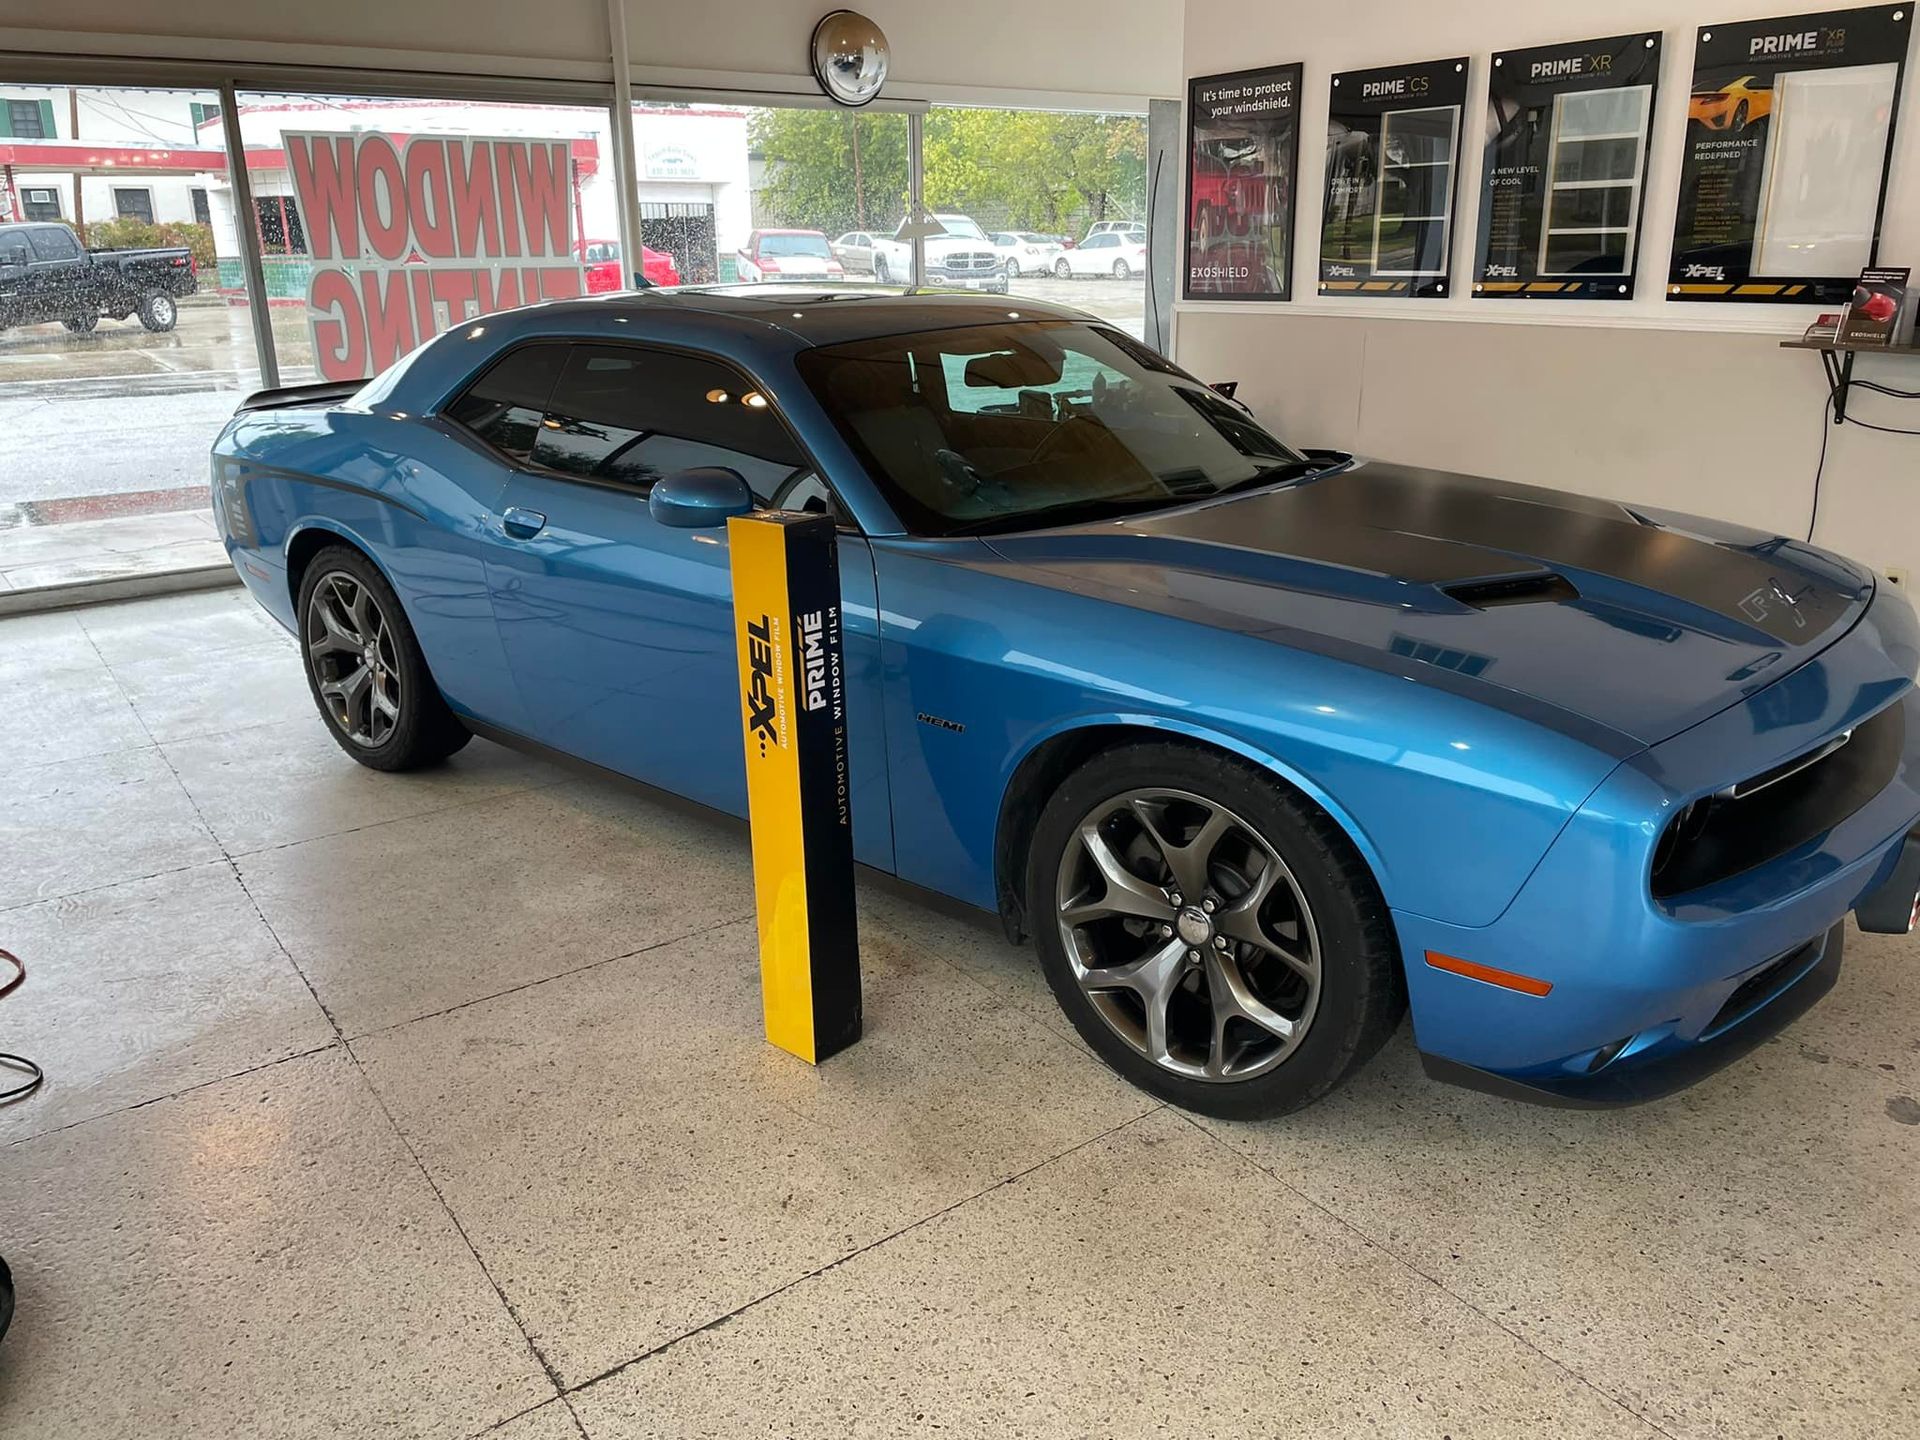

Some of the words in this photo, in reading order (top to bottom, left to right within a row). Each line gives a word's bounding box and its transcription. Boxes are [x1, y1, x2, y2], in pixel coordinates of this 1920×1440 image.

[1749, 31, 1818, 55] PRIME
[1827, 28, 1846, 40] XR
[1531, 58, 1582, 78] PRIME
[1589, 54, 1612, 71] XR
[1203, 90, 1217, 102] It's
[1218, 87, 1240, 100] time
[1242, 86, 1253, 97] to
[1254, 80, 1291, 97] protect
[1363, 80, 1405, 97] PRIME
[1410, 76, 1429, 92] CS
[1211, 105, 1233, 118] your
[1234, 96, 1291, 113] windshield.
[1694, 151, 1740, 160] REDEFINED
[1695, 139, 1758, 150] PERFORMANCE
[1497, 167, 1515, 175] NEW
[1516, 166, 1539, 174] LEVEL
[1191, 266, 1249, 279] EXOSHIELD
[1331, 265, 1355, 277] XPEL
[1485, 264, 1518, 277] XPEL
[1684, 264, 1726, 278] XPEL
[773, 617, 781, 641] FILM
[828, 606, 838, 644] FILM
[774, 645, 783, 684] WINDOW
[803, 610, 827, 712] PRIME
[747, 614, 778, 746] XPEL
[830, 653, 842, 720] WINDOW
[777, 688, 788, 749] AUTOMOTIVE
[917, 712, 966, 733] HEMI
[834, 725, 847, 824] AUTOMOTIVE
